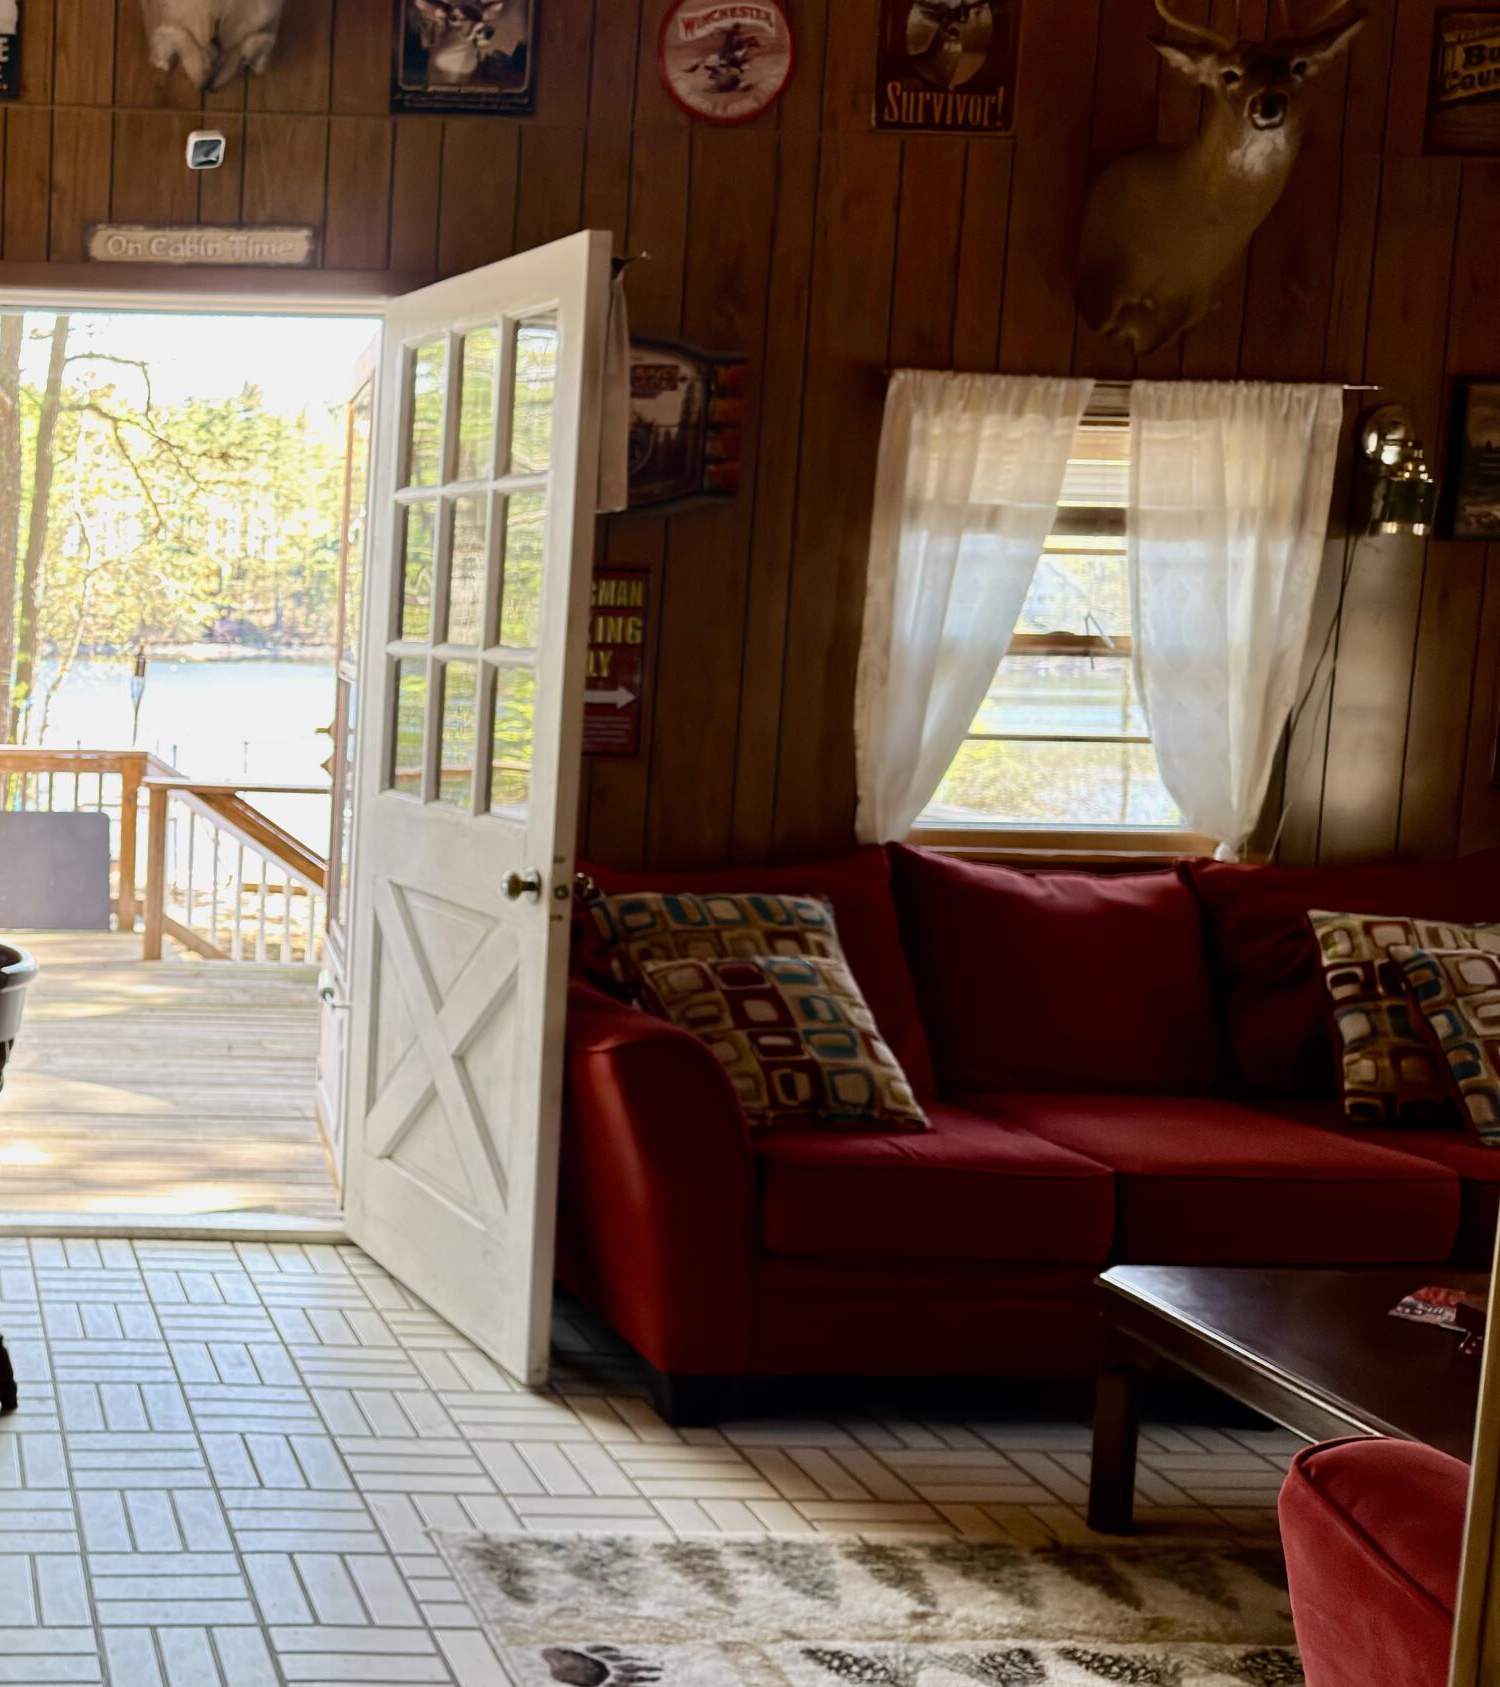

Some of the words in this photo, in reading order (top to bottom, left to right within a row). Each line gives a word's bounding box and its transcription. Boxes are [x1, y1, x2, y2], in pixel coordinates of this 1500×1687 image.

[884, 81, 1005, 127] Survivor!
[107, 235, 143, 256] On
[150, 235, 221, 257] Cabin
[227, 235, 293, 257] Time
